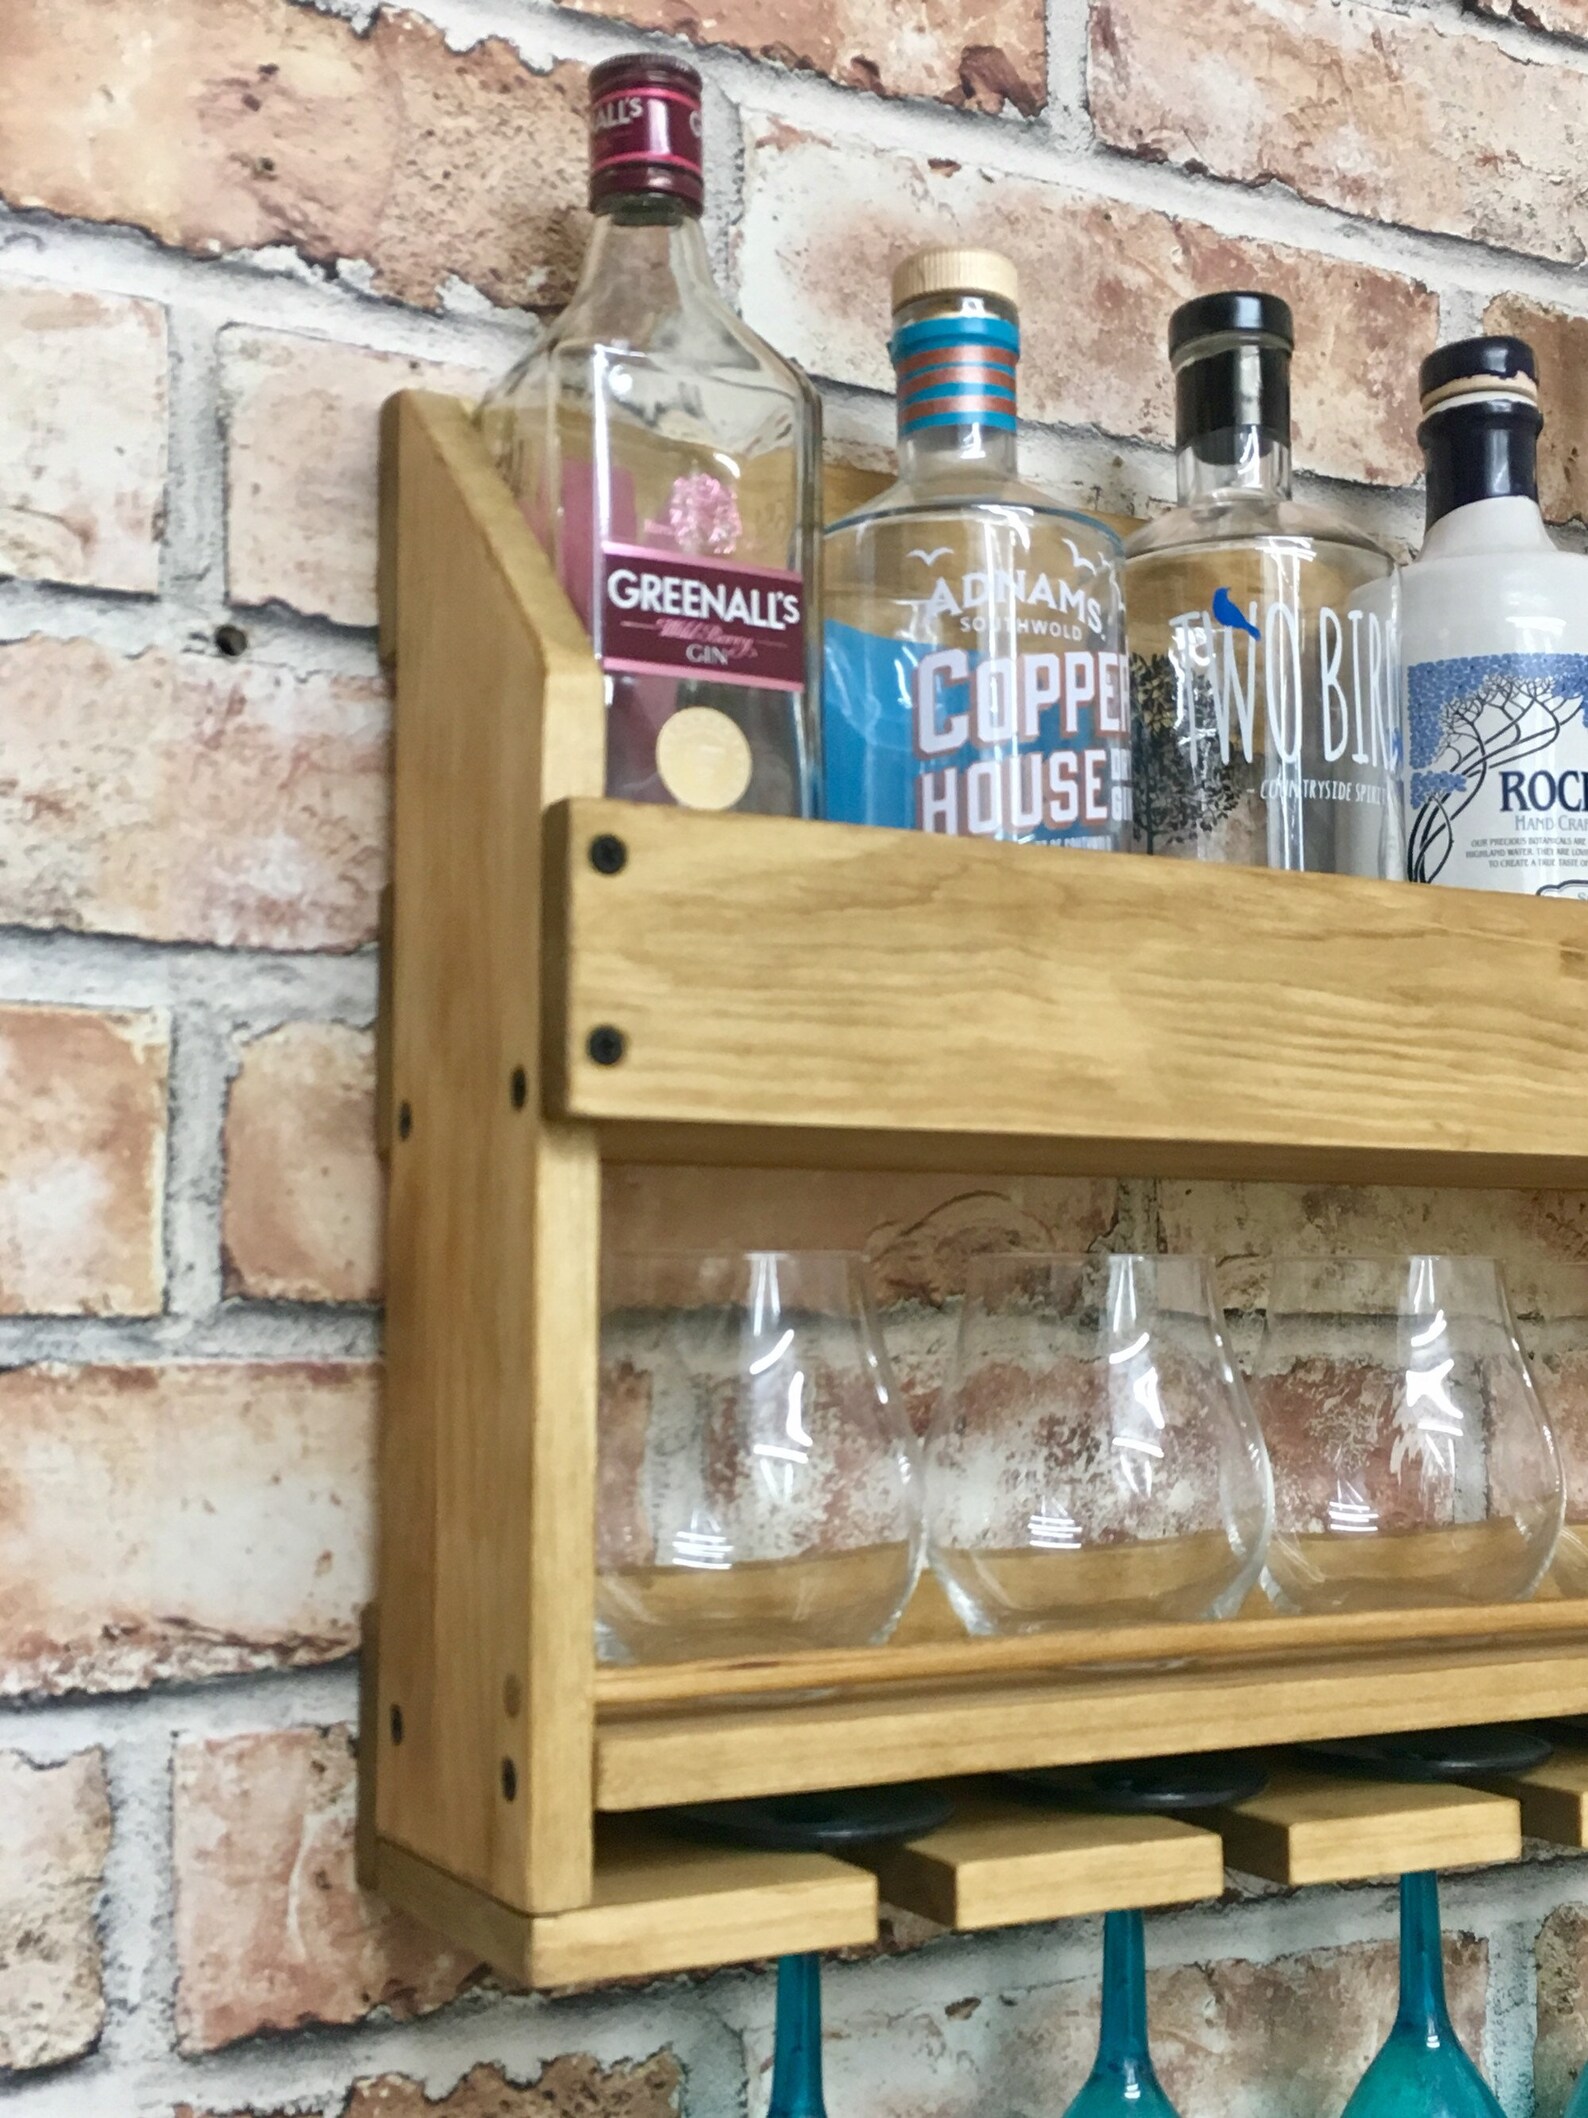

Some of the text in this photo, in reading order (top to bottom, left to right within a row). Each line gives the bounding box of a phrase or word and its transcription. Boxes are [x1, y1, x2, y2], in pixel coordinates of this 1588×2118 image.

[607, 569, 801, 631] GREENALL'S
[959, 616, 1083, 642] SOUTHWOLD
[686, 643, 729, 665] GIN
[1168, 600, 1303, 770] TWO
[918, 748, 1109, 837] HOUSE
